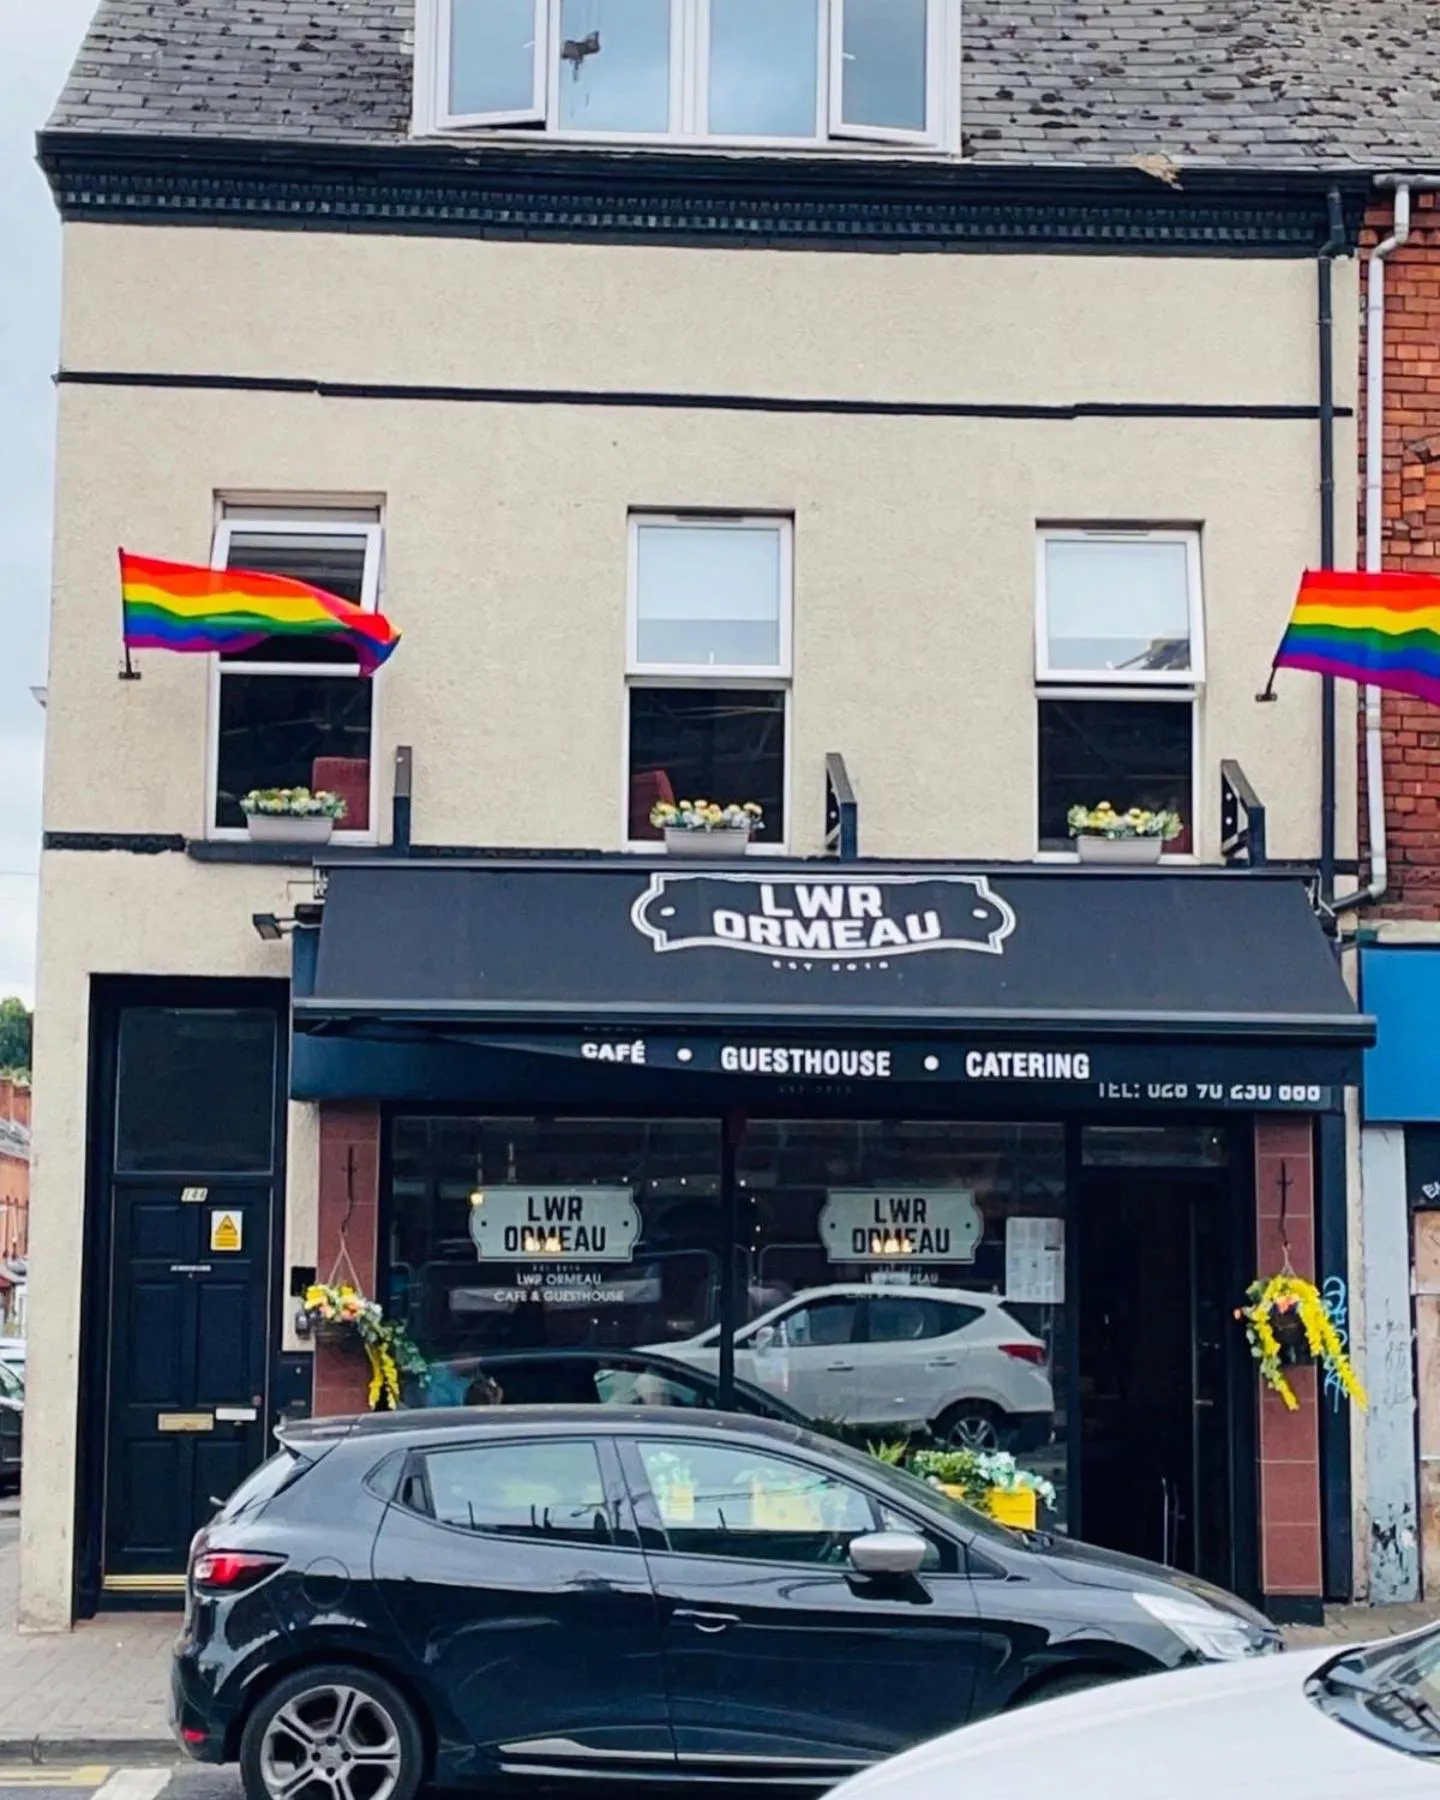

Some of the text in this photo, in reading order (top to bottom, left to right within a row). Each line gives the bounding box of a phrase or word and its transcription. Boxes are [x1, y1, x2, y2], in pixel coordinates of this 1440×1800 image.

[760, 884, 882, 919] LWR
[713, 910, 941, 949] ORMEAU
[581, 1041, 1090, 1079] CAFÉ GUESTHOUSE CATERING
[527, 1196, 583, 1222] LWR
[874, 1198, 927, 1224] LWR
